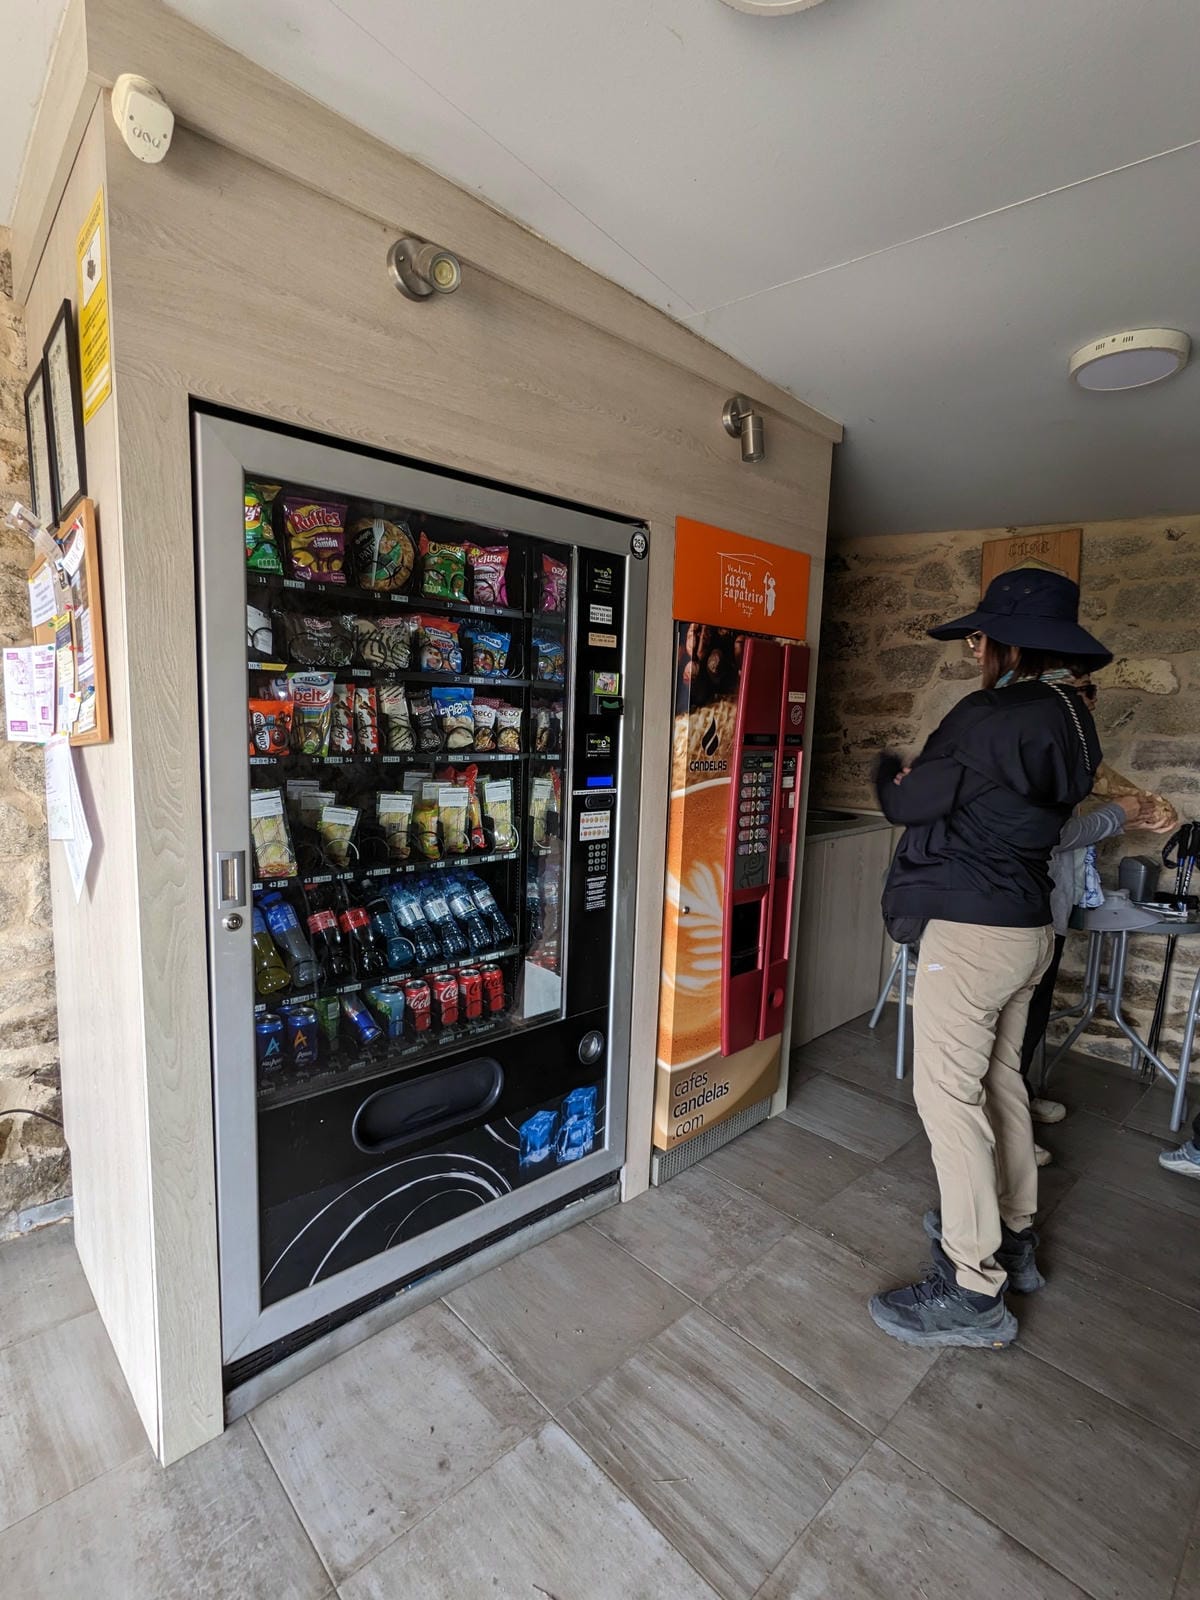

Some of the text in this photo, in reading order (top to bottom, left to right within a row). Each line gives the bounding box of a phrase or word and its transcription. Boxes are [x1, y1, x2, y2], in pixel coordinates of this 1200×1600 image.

[289, 507, 340, 533] Ruffles
[723, 587, 764, 604] zapateiro
[689, 760, 728, 773] CANDELAS
[674, 1071, 708, 1097] cafes
[673, 1081, 729, 1118] candelas
[672, 1114, 704, 1140] .com
